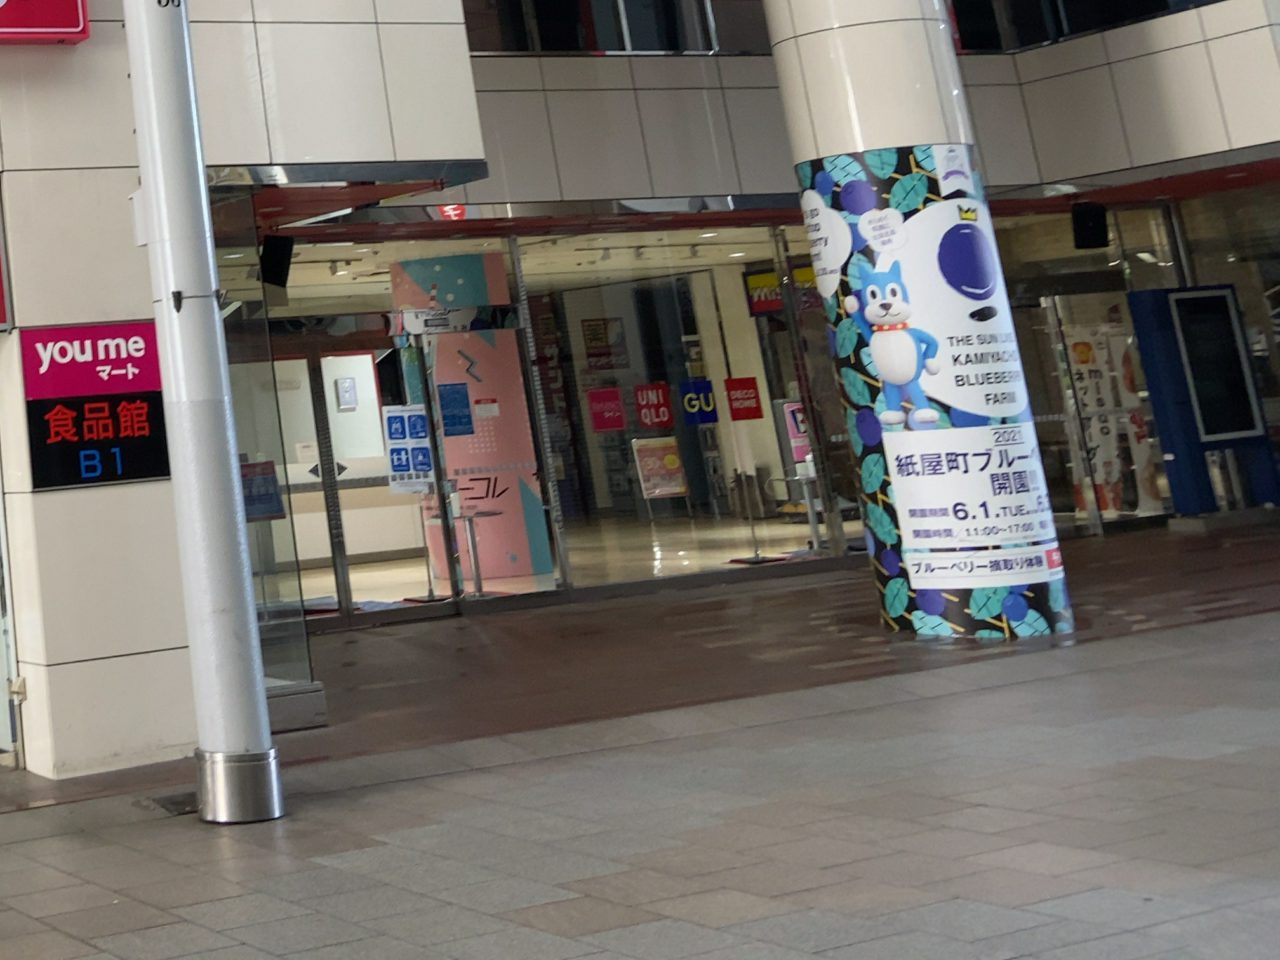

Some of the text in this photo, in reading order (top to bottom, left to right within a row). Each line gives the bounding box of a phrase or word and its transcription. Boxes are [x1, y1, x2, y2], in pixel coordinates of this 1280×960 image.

[95, 362, 140, 381] マート
[636, 388, 664, 406] UNI
[683, 392, 715, 413] GU
[43, 399, 151, 445] 食品館
[640, 407, 670, 424] QLO
[79, 447, 124, 479] B1
